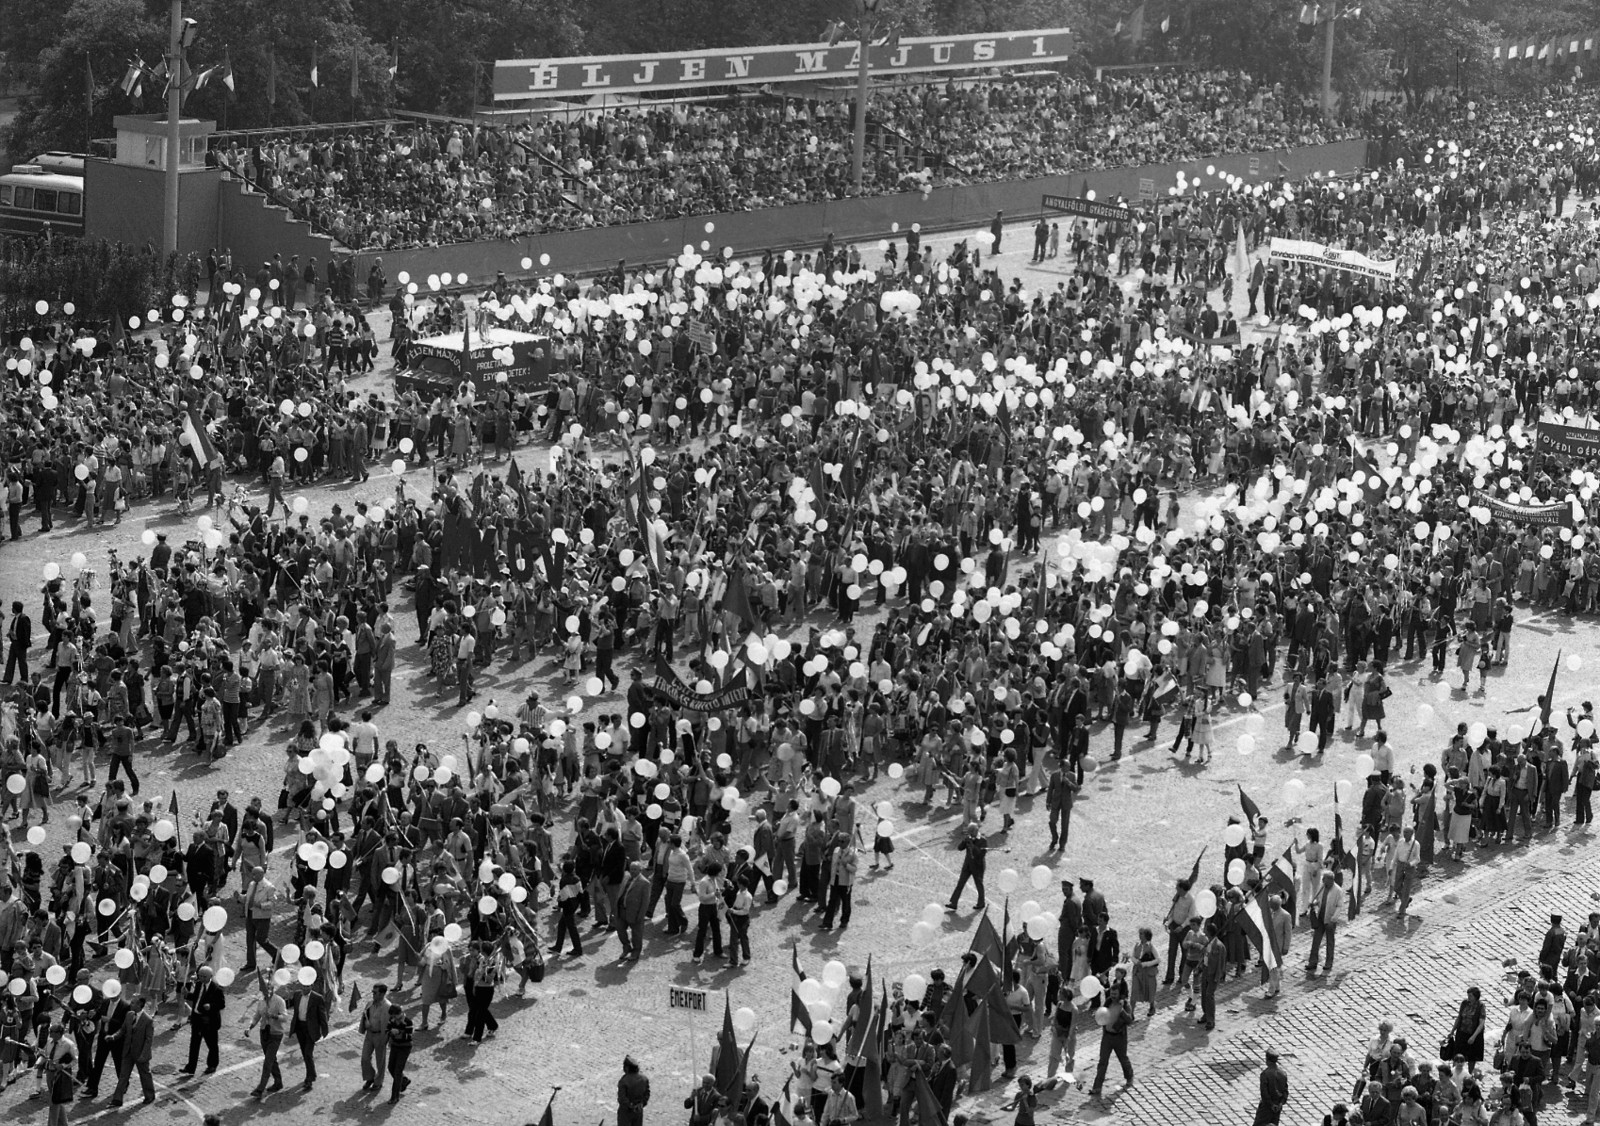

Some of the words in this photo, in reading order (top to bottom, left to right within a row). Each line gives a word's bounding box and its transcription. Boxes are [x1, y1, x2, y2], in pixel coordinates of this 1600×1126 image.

[529, 56, 754, 90] ÉLJEN
[1032, 37, 1053, 57] 1.
[1045, 197, 1087, 212] ANGYALFÖLDI
[1089, 204, 1129, 220] GYÁREGYSÉG
[409, 347, 434, 359] ÉLJEN
[436, 347, 461, 366] MÁJUS
